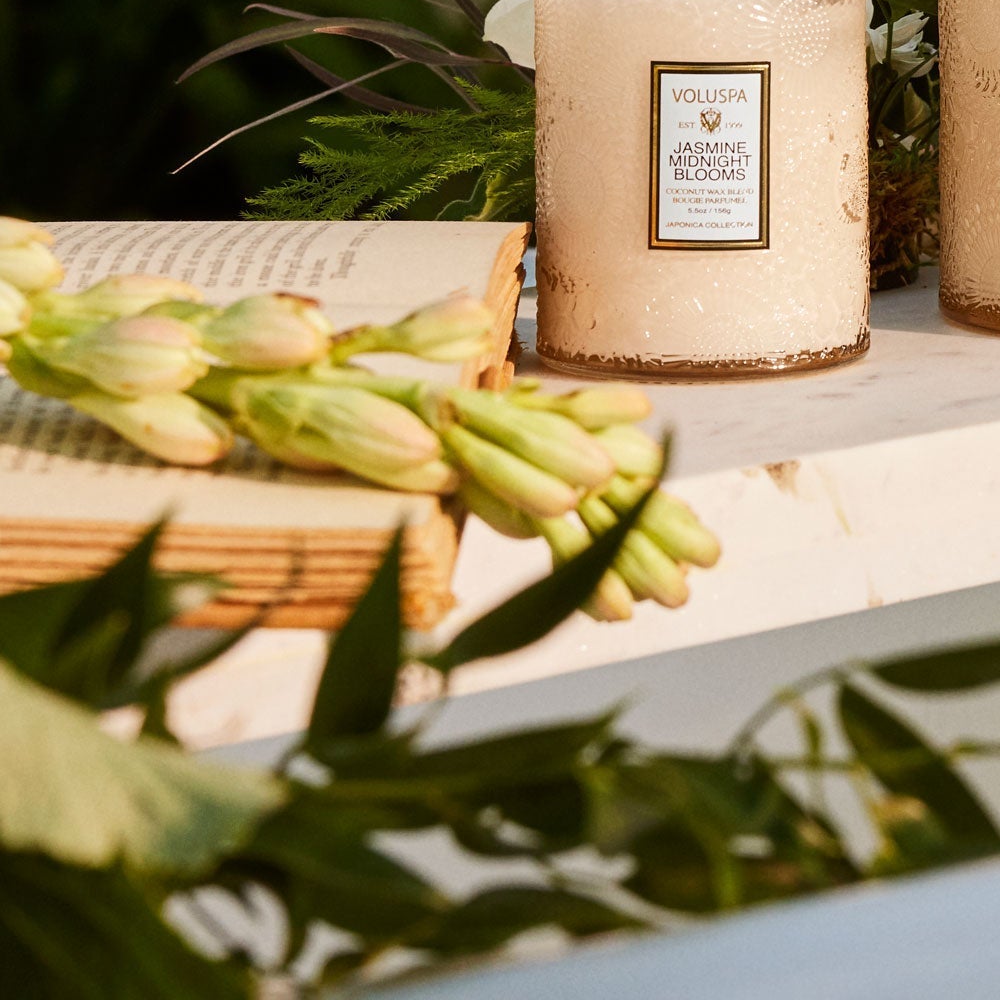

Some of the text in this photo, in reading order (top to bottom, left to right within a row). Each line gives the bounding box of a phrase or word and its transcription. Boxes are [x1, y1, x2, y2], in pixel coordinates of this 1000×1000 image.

[672, 88, 748, 104] VOLUSPA
[673, 141, 747, 154] JASMINE
[669, 155, 752, 168] MIDNIGHT
[674, 168, 746, 181] BLOOMS
